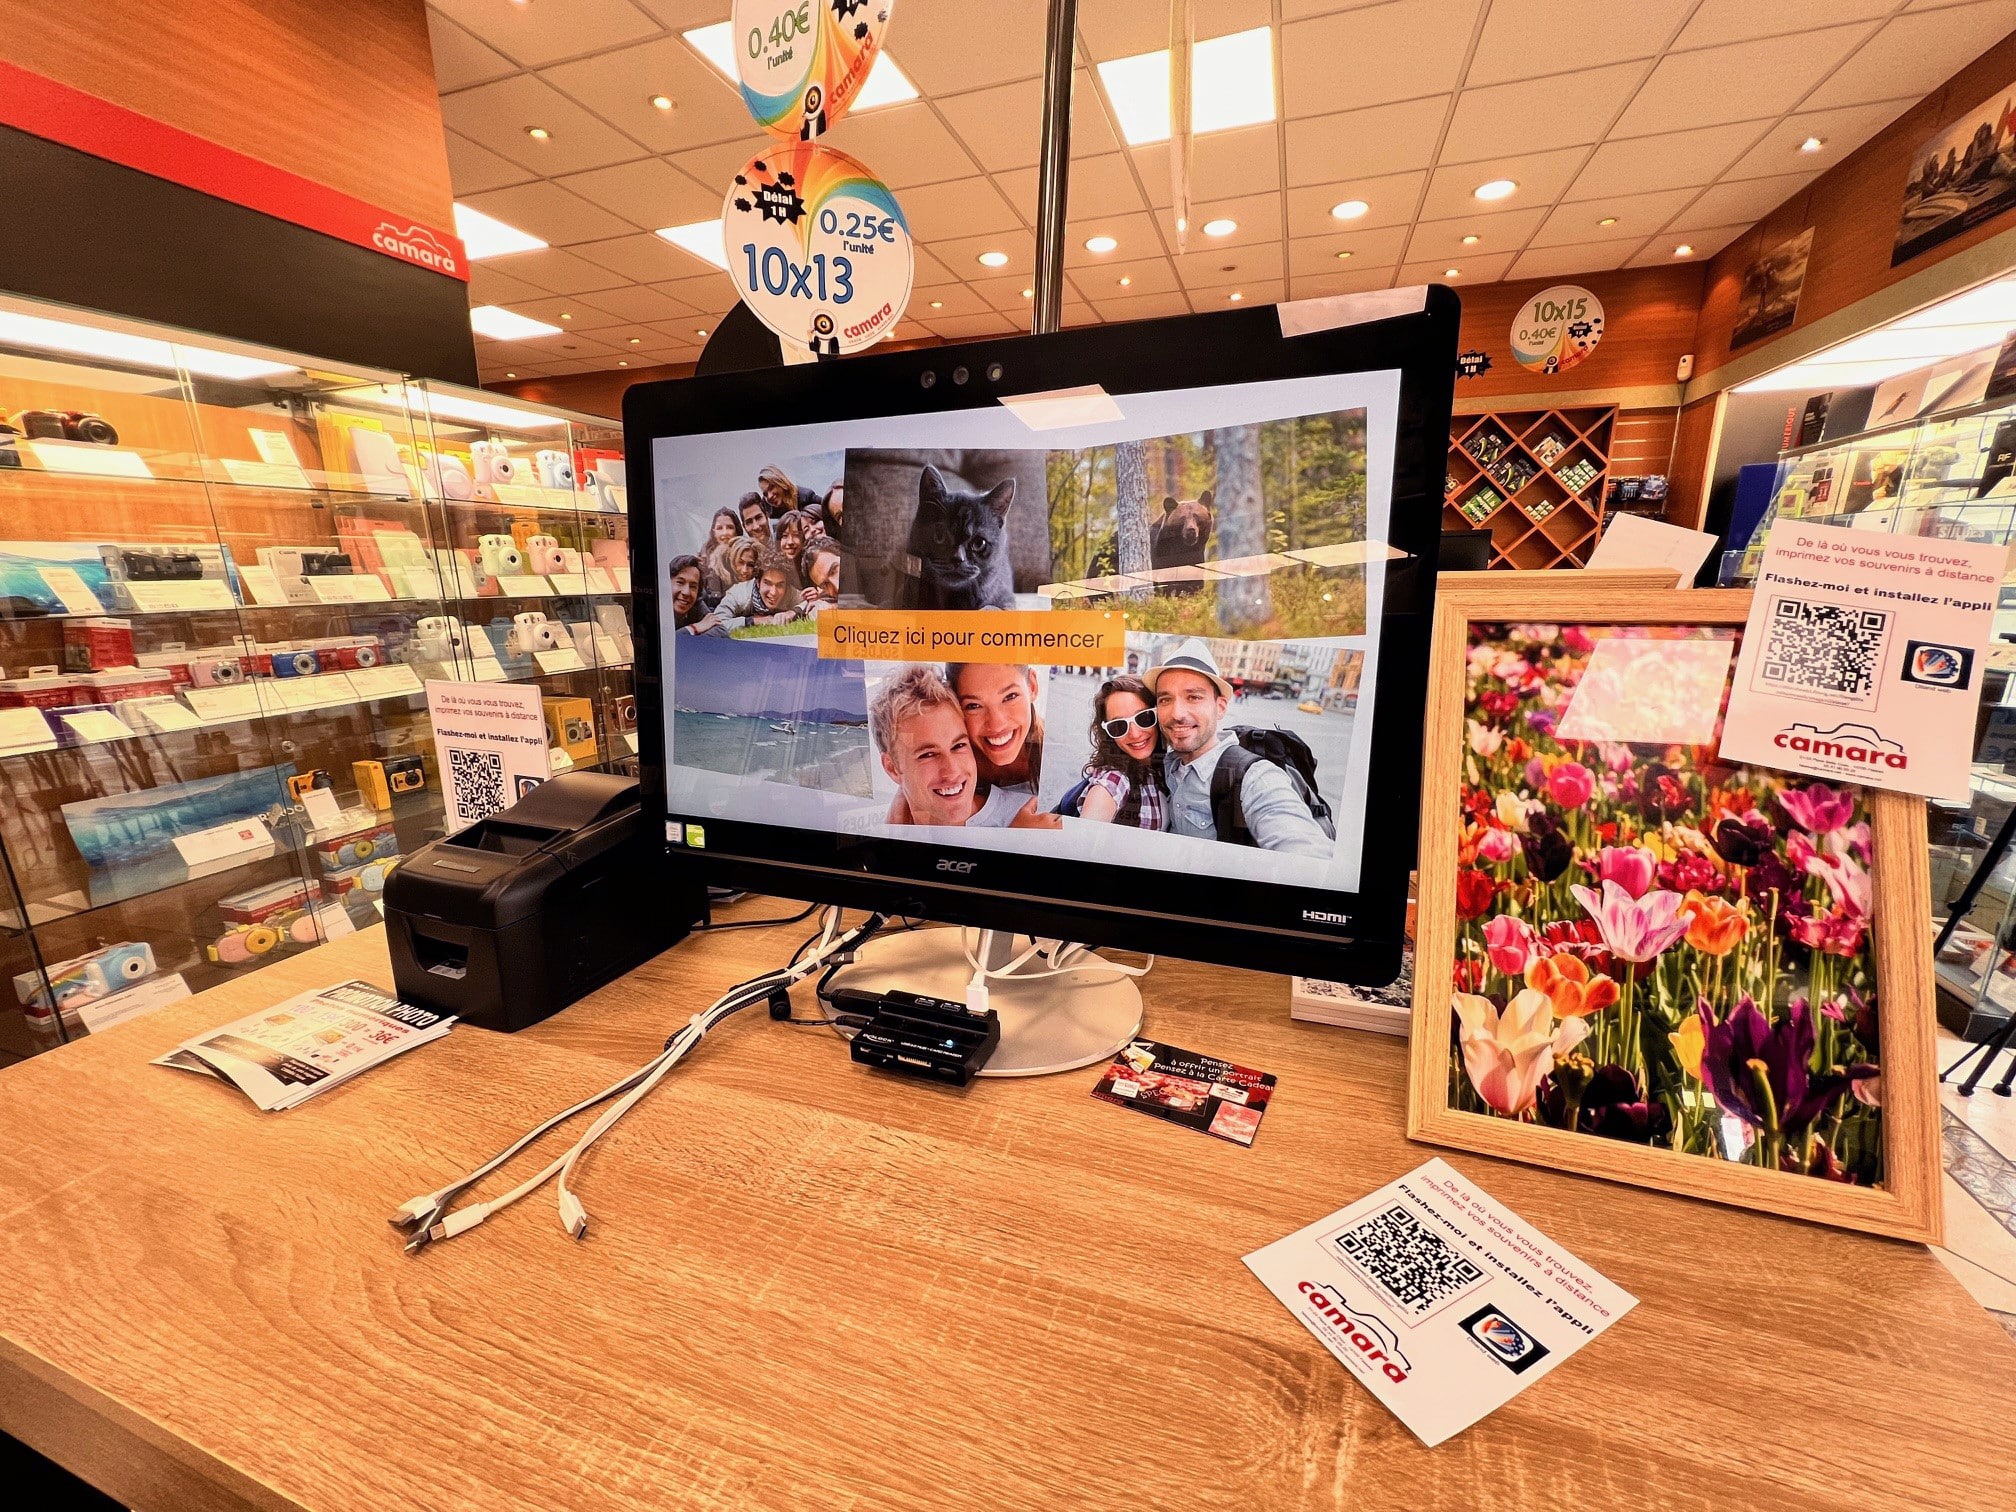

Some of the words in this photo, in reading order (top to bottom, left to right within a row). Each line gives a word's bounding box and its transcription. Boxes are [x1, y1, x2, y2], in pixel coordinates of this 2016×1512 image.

[748, 1, 810, 58] 0.40€
[830, 30, 873, 104] camara
[763, 190, 793, 206] Délai
[820, 209, 895, 243] 0.25€
[372, 232, 456, 272] camara
[843, 240, 875, 255] l'unité
[743, 243, 854, 304] 10x13
[844, 302, 893, 339] camara
[1534, 297, 1588, 323] 10x15
[1519, 327, 1557, 341] 0.40€
[1460, 355, 1483, 364] Délai
[1776, 548, 1832, 564] imprimez
[1834, 557, 1855, 567] vos
[1859, 559, 1922, 575] souvenirs
[1925, 567, 1934, 577] à
[1937, 568, 1995, 584] distance
[1797, 537, 1813, 548] De
[1818, 538, 1828, 550] là
[1831, 542, 1848, 552] où
[1851, 546, 1881, 557] vous
[1885, 550, 1916, 561] vous
[1919, 553, 1973, 569] trouvez,
[1765, 573, 1850, 592] Flashez-moi
[1854, 586, 1869, 596] et
[1874, 588, 1939, 605] installez
[1943, 597, 1993, 612] l'appli
[833, 625, 900, 648] Cliquez
[905, 626, 925, 645] ici
[931, 631, 976, 650] pour
[981, 631, 1104, 649] commencer
[441, 695, 450, 704] De
[474, 709, 504, 719] souvenirs
[511, 711, 538, 721] distance
[437, 728, 477, 739] Flashez-moi
[479, 731, 486, 740] et
[488, 733, 518, 743] installez
[1773, 733, 1908, 770] camara
[936, 859, 977, 874] acer
[1303, 910, 1347, 923] HDMI
[394, 1004, 440, 1027] PHOTO
[1154, 1062, 1187, 1075] Pensez
[1207, 1073, 1236, 1084] Carte
[1179, 1061, 1206, 1071] offrir
[1222, 1069, 1263, 1082] portrait
[1200, 1057, 1234, 1070] Pensez
[1443, 1180, 1459, 1193] De
[1460, 1190, 1470, 1202] là
[1472, 1201, 1488, 1214] où
[1488, 1213, 1514, 1235] vous
[1516, 1233, 1543, 1256] vous
[1420, 1174, 1466, 1212] imprimez
[1467, 1210, 1486, 1227] vos
[1487, 1225, 1543, 1269] souvenirs
[1544, 1267, 1553, 1277] à
[1555, 1274, 1611, 1318] distance
[1398, 1184, 1468, 1239] Flashez-moi
[1468, 1238, 1483, 1252] et
[1484, 1251, 1544, 1298] installez
[1545, 1298, 1595, 1335] l'appli
[1298, 1281, 1408, 1384] camara
